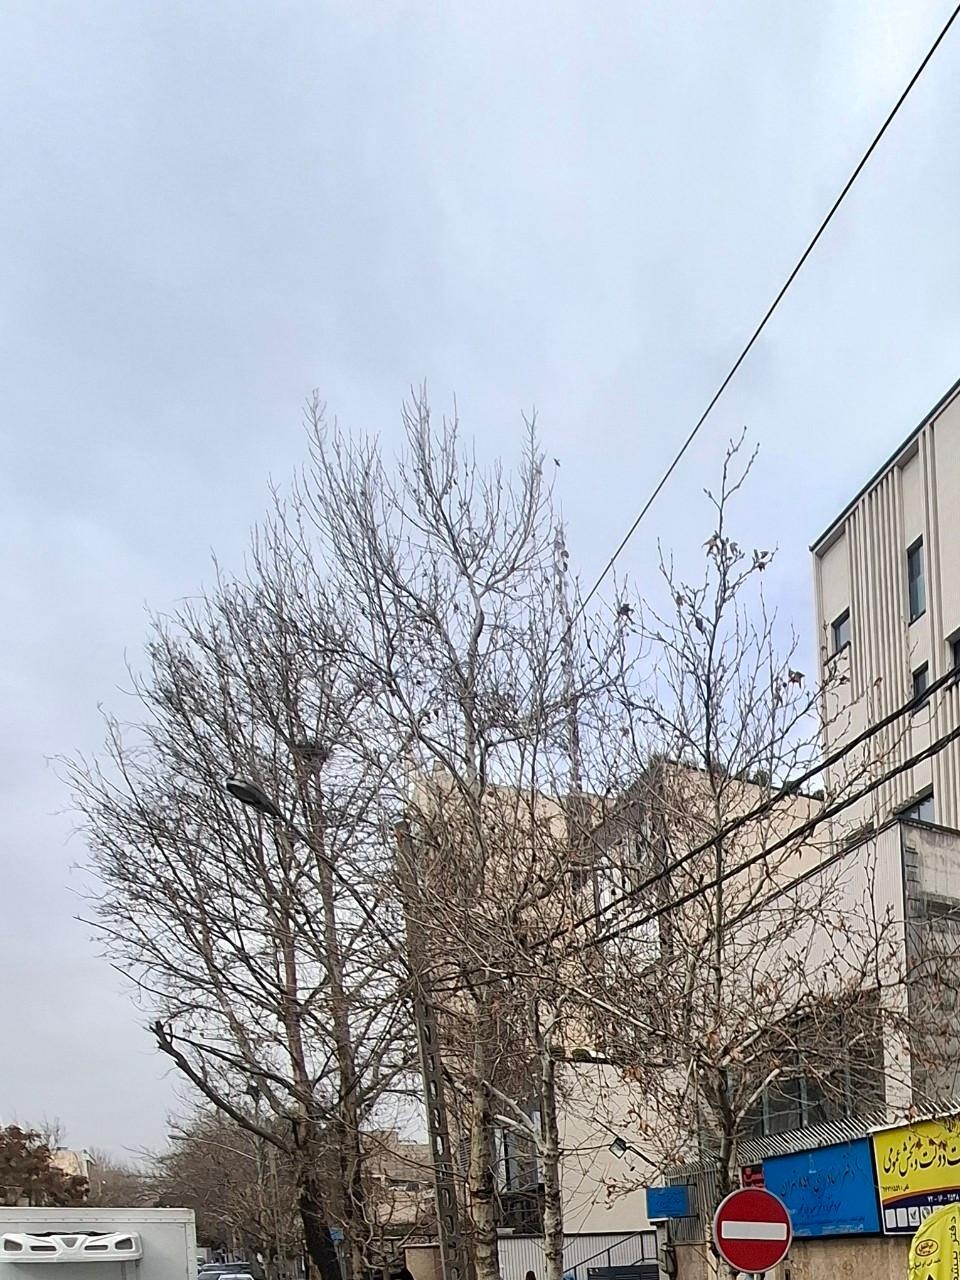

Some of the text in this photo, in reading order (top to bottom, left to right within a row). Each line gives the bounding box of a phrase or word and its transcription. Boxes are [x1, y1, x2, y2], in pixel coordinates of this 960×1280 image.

[883, 1147, 901, 1174] عمومی
[899, 1136, 917, 1177] بخش
[919, 1143, 947, 1169] دولت
[948, 1215, 960, 1246] دفتر
